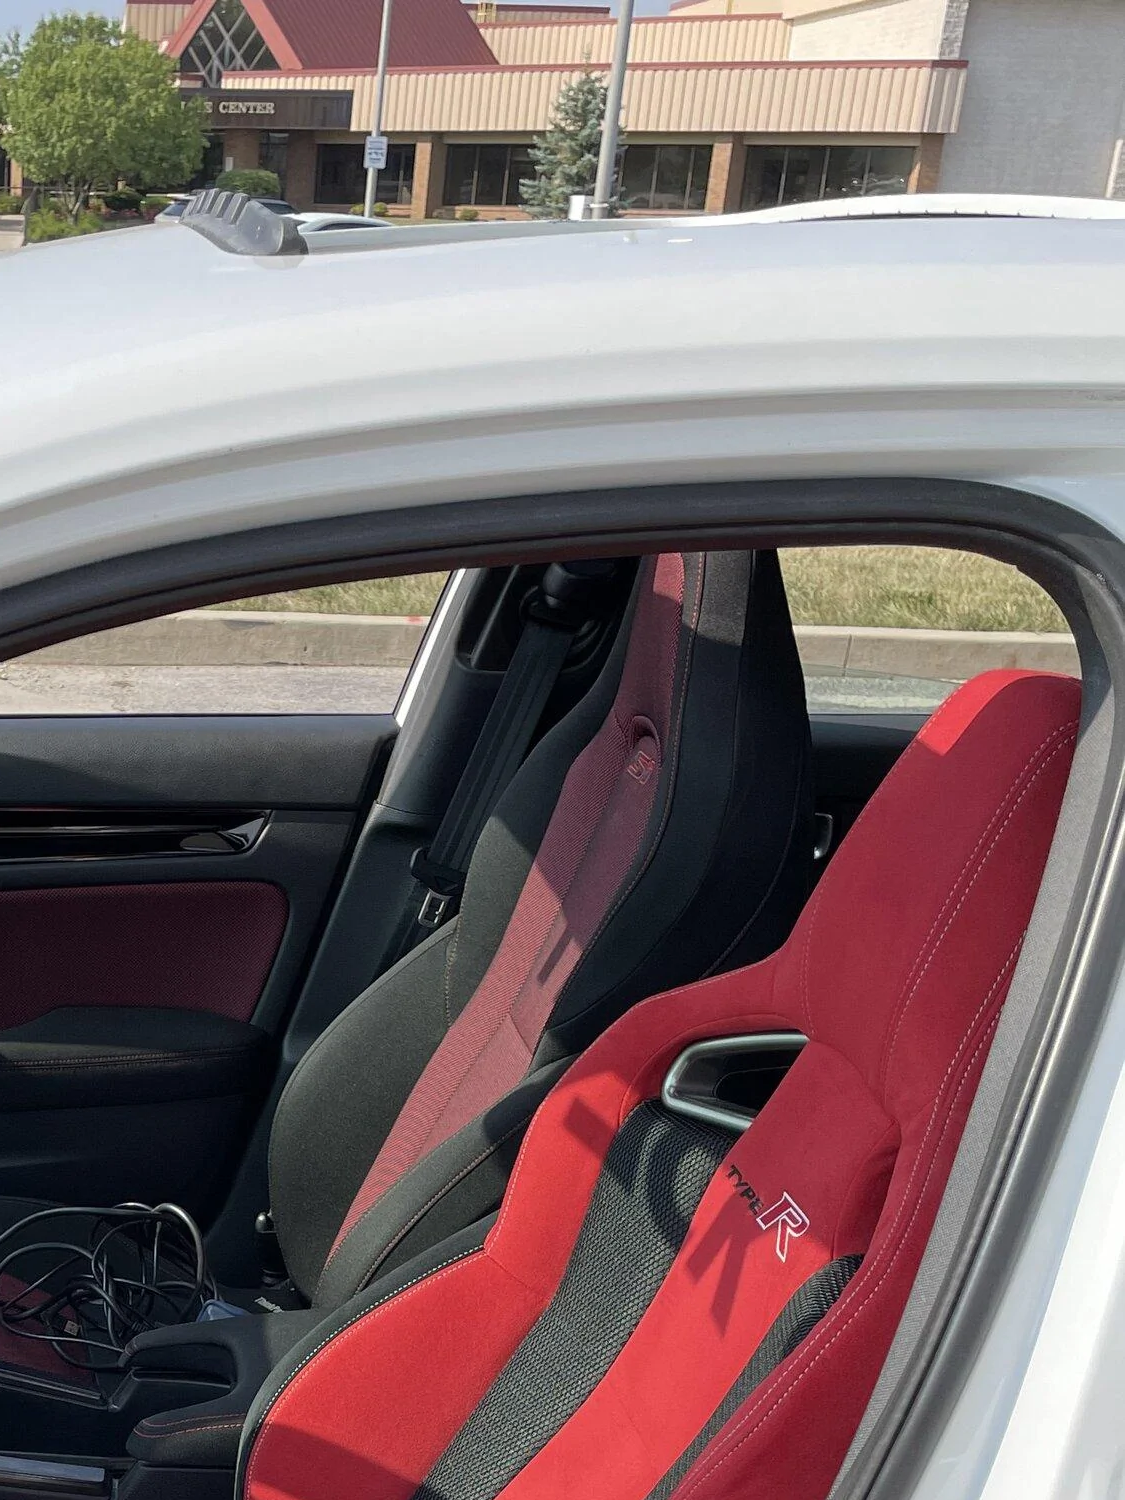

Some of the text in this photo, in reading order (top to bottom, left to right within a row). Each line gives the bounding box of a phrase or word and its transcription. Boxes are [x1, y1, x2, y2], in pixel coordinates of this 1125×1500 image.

[219, 101, 275, 114] CENTER
[726, 1164, 811, 1263] TYPE R
